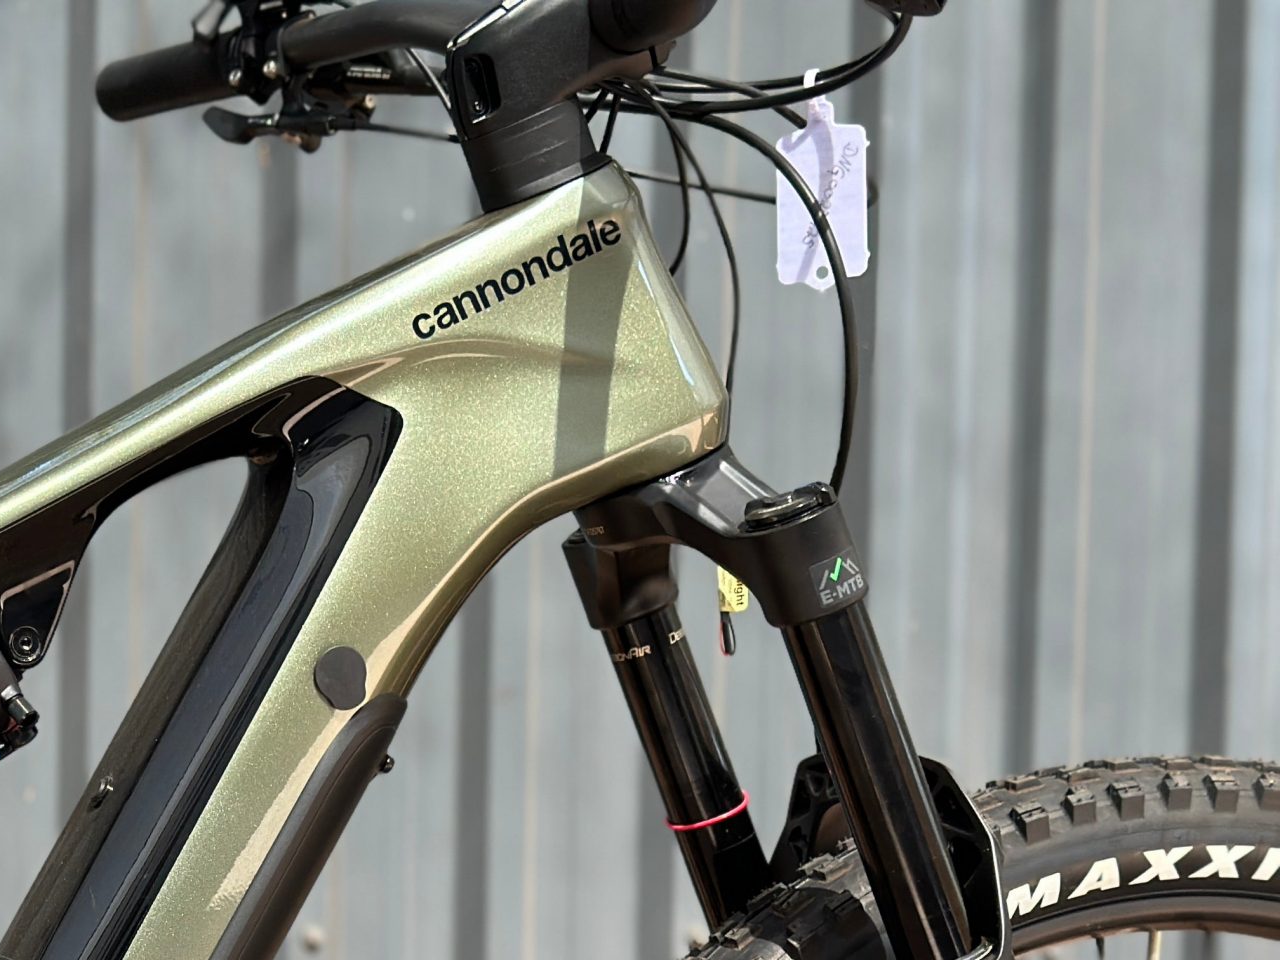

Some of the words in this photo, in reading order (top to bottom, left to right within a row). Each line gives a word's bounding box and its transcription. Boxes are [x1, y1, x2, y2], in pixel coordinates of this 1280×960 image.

[412, 219, 622, 340] cannondale
[733, 579, 745, 606] ight
[819, 572, 864, 605] E-MTB
[1006, 844, 1280, 920] MAXXI
